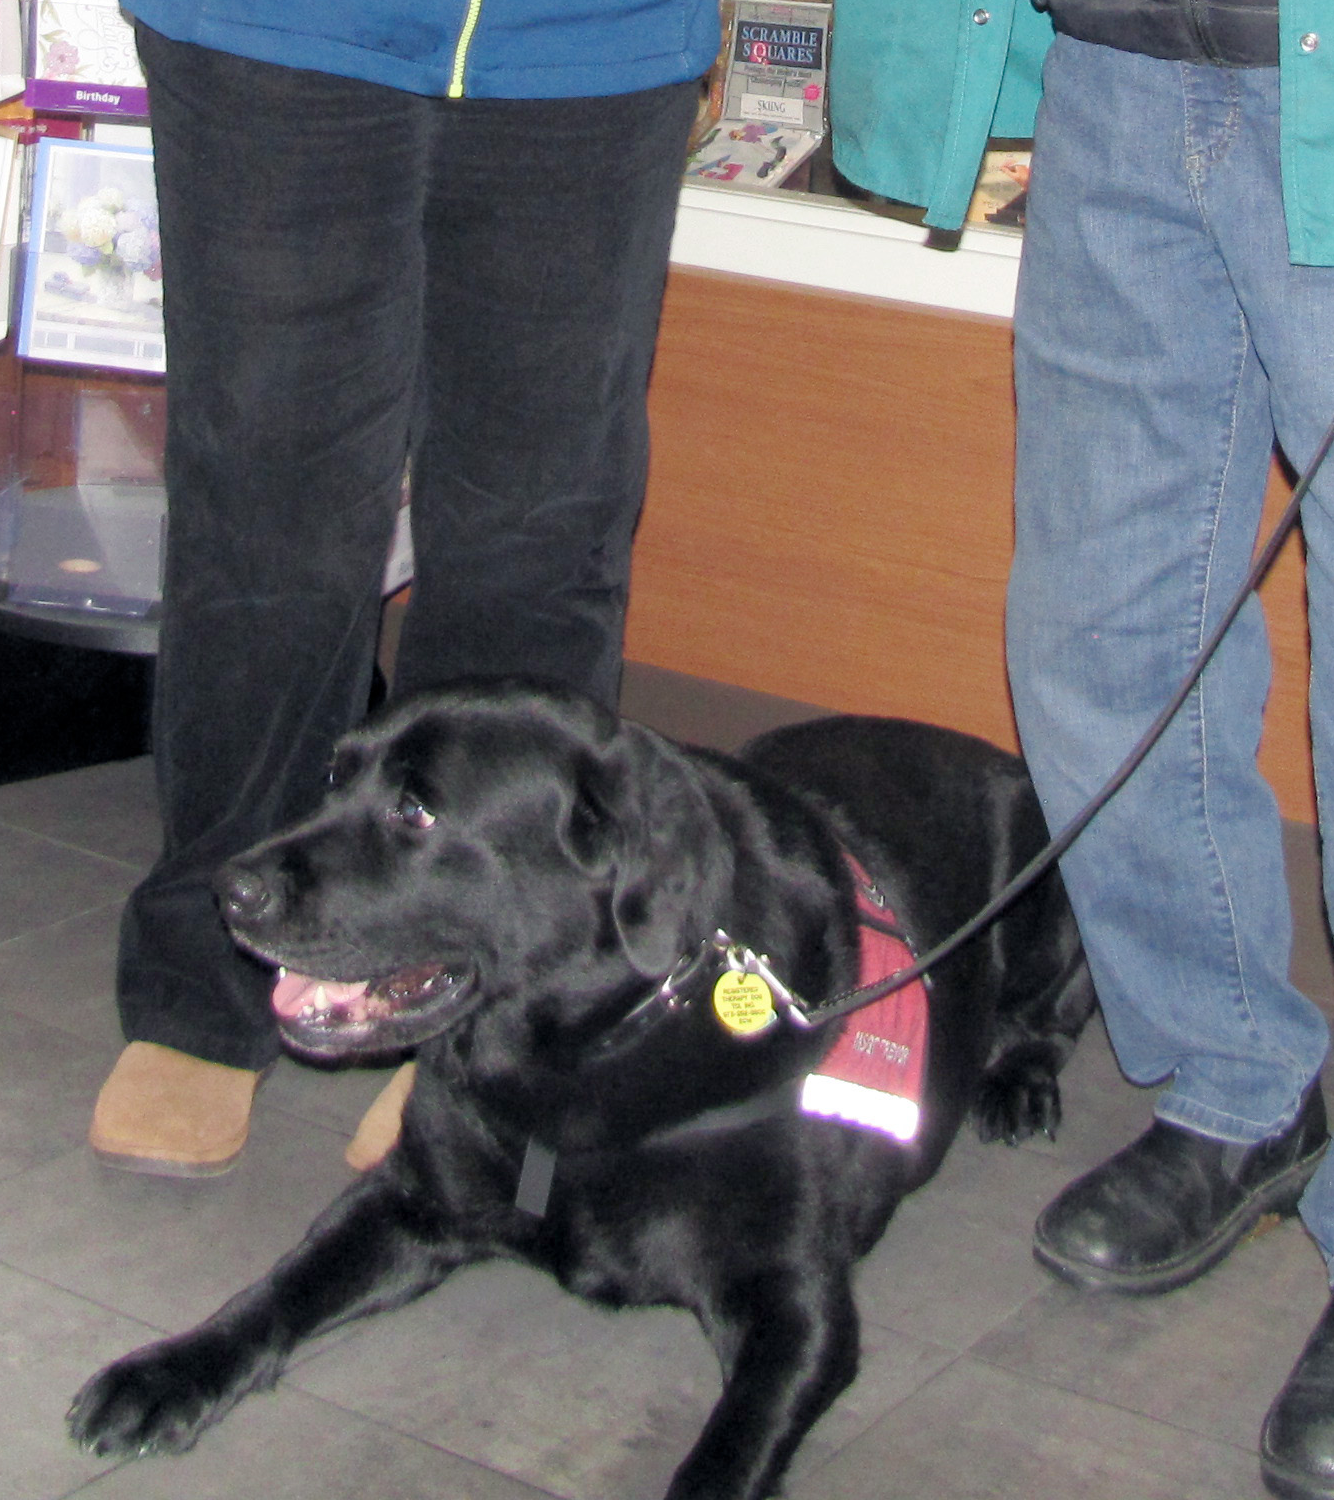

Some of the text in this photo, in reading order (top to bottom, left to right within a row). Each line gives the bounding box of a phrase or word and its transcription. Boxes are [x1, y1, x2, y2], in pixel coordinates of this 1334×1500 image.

[741, 26, 818, 47] SCRAMBLE
[742, 42, 813, 65] SQUARES
[75, 90, 120, 105] Birthday
[757, 99, 786, 113] SKIING
